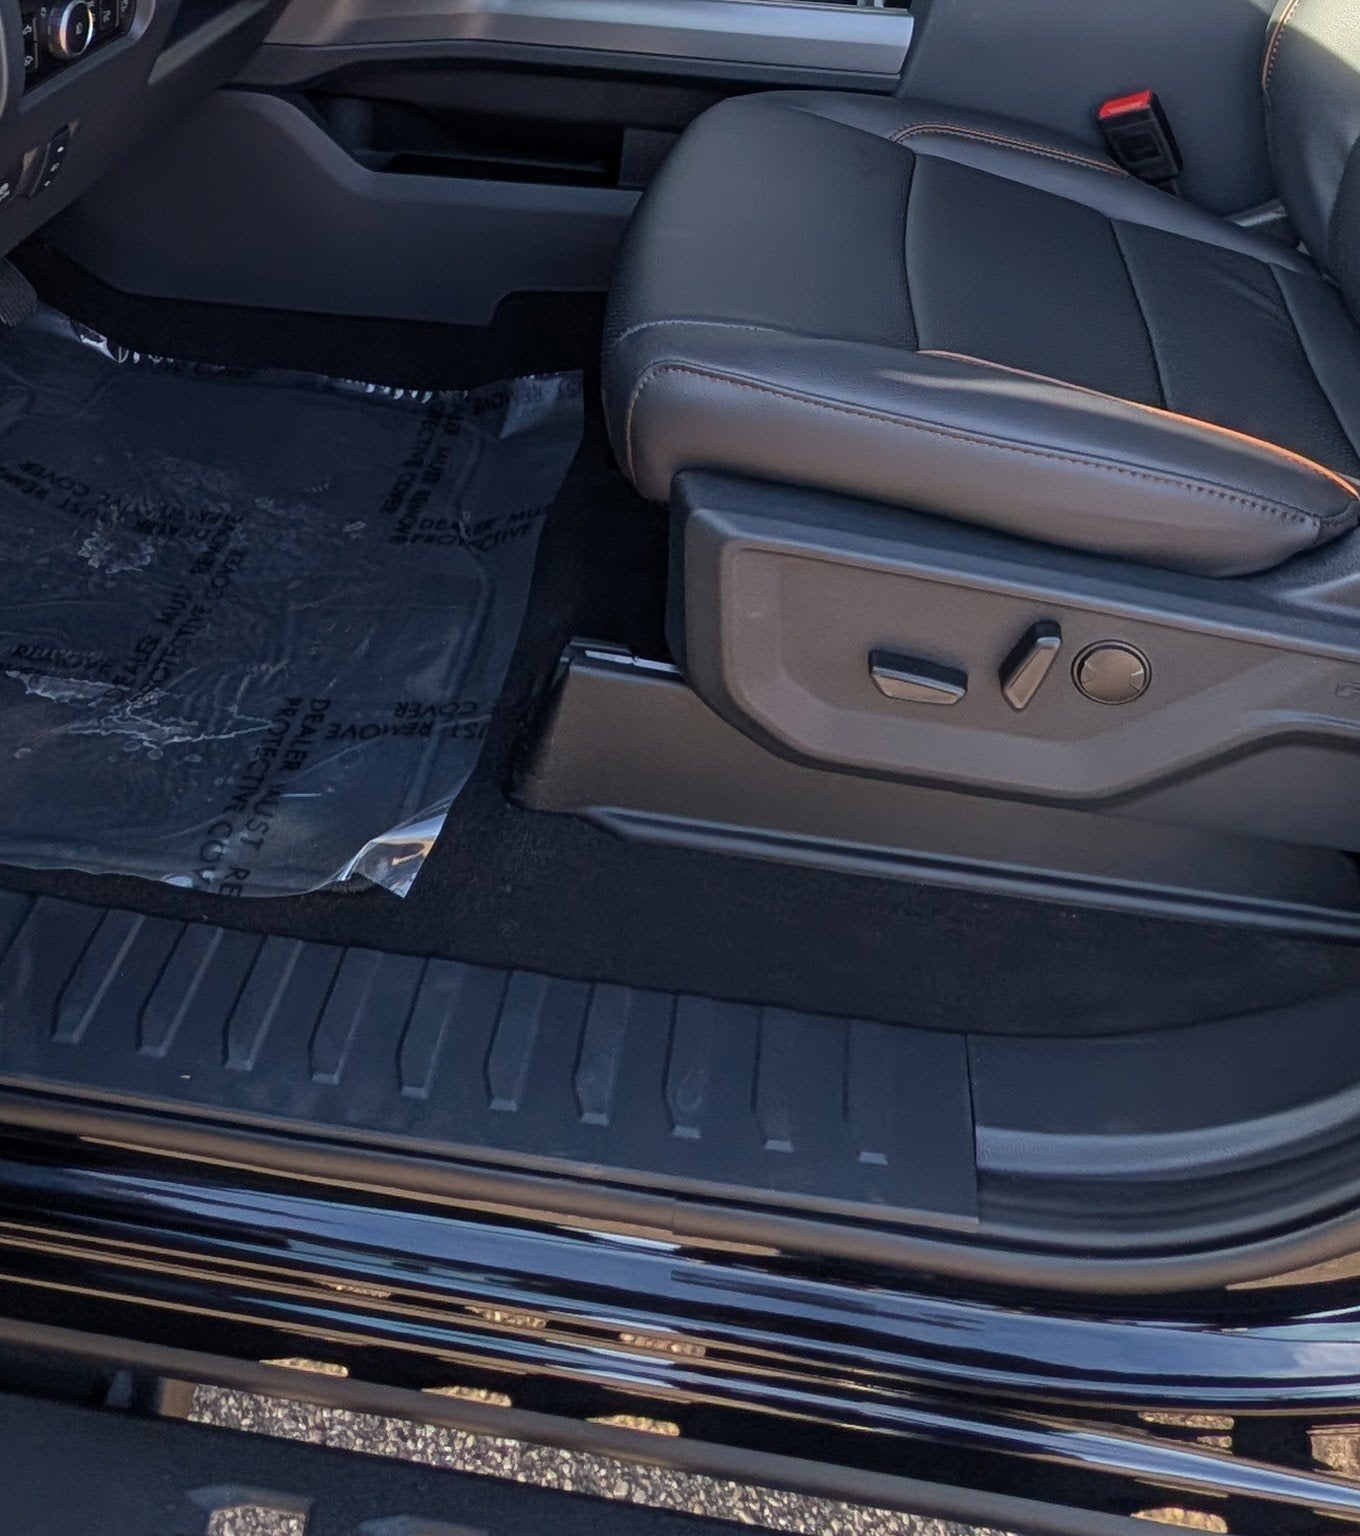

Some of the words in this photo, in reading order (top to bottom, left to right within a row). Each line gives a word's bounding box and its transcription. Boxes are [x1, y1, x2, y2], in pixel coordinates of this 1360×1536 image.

[279, 697, 332, 773] DEALER
[325, 720, 436, 742] REMOVE
[393, 700, 480, 720] COVER
[222, 697, 304, 814] PROTECTIVE
[241, 784, 286, 852] MUST
